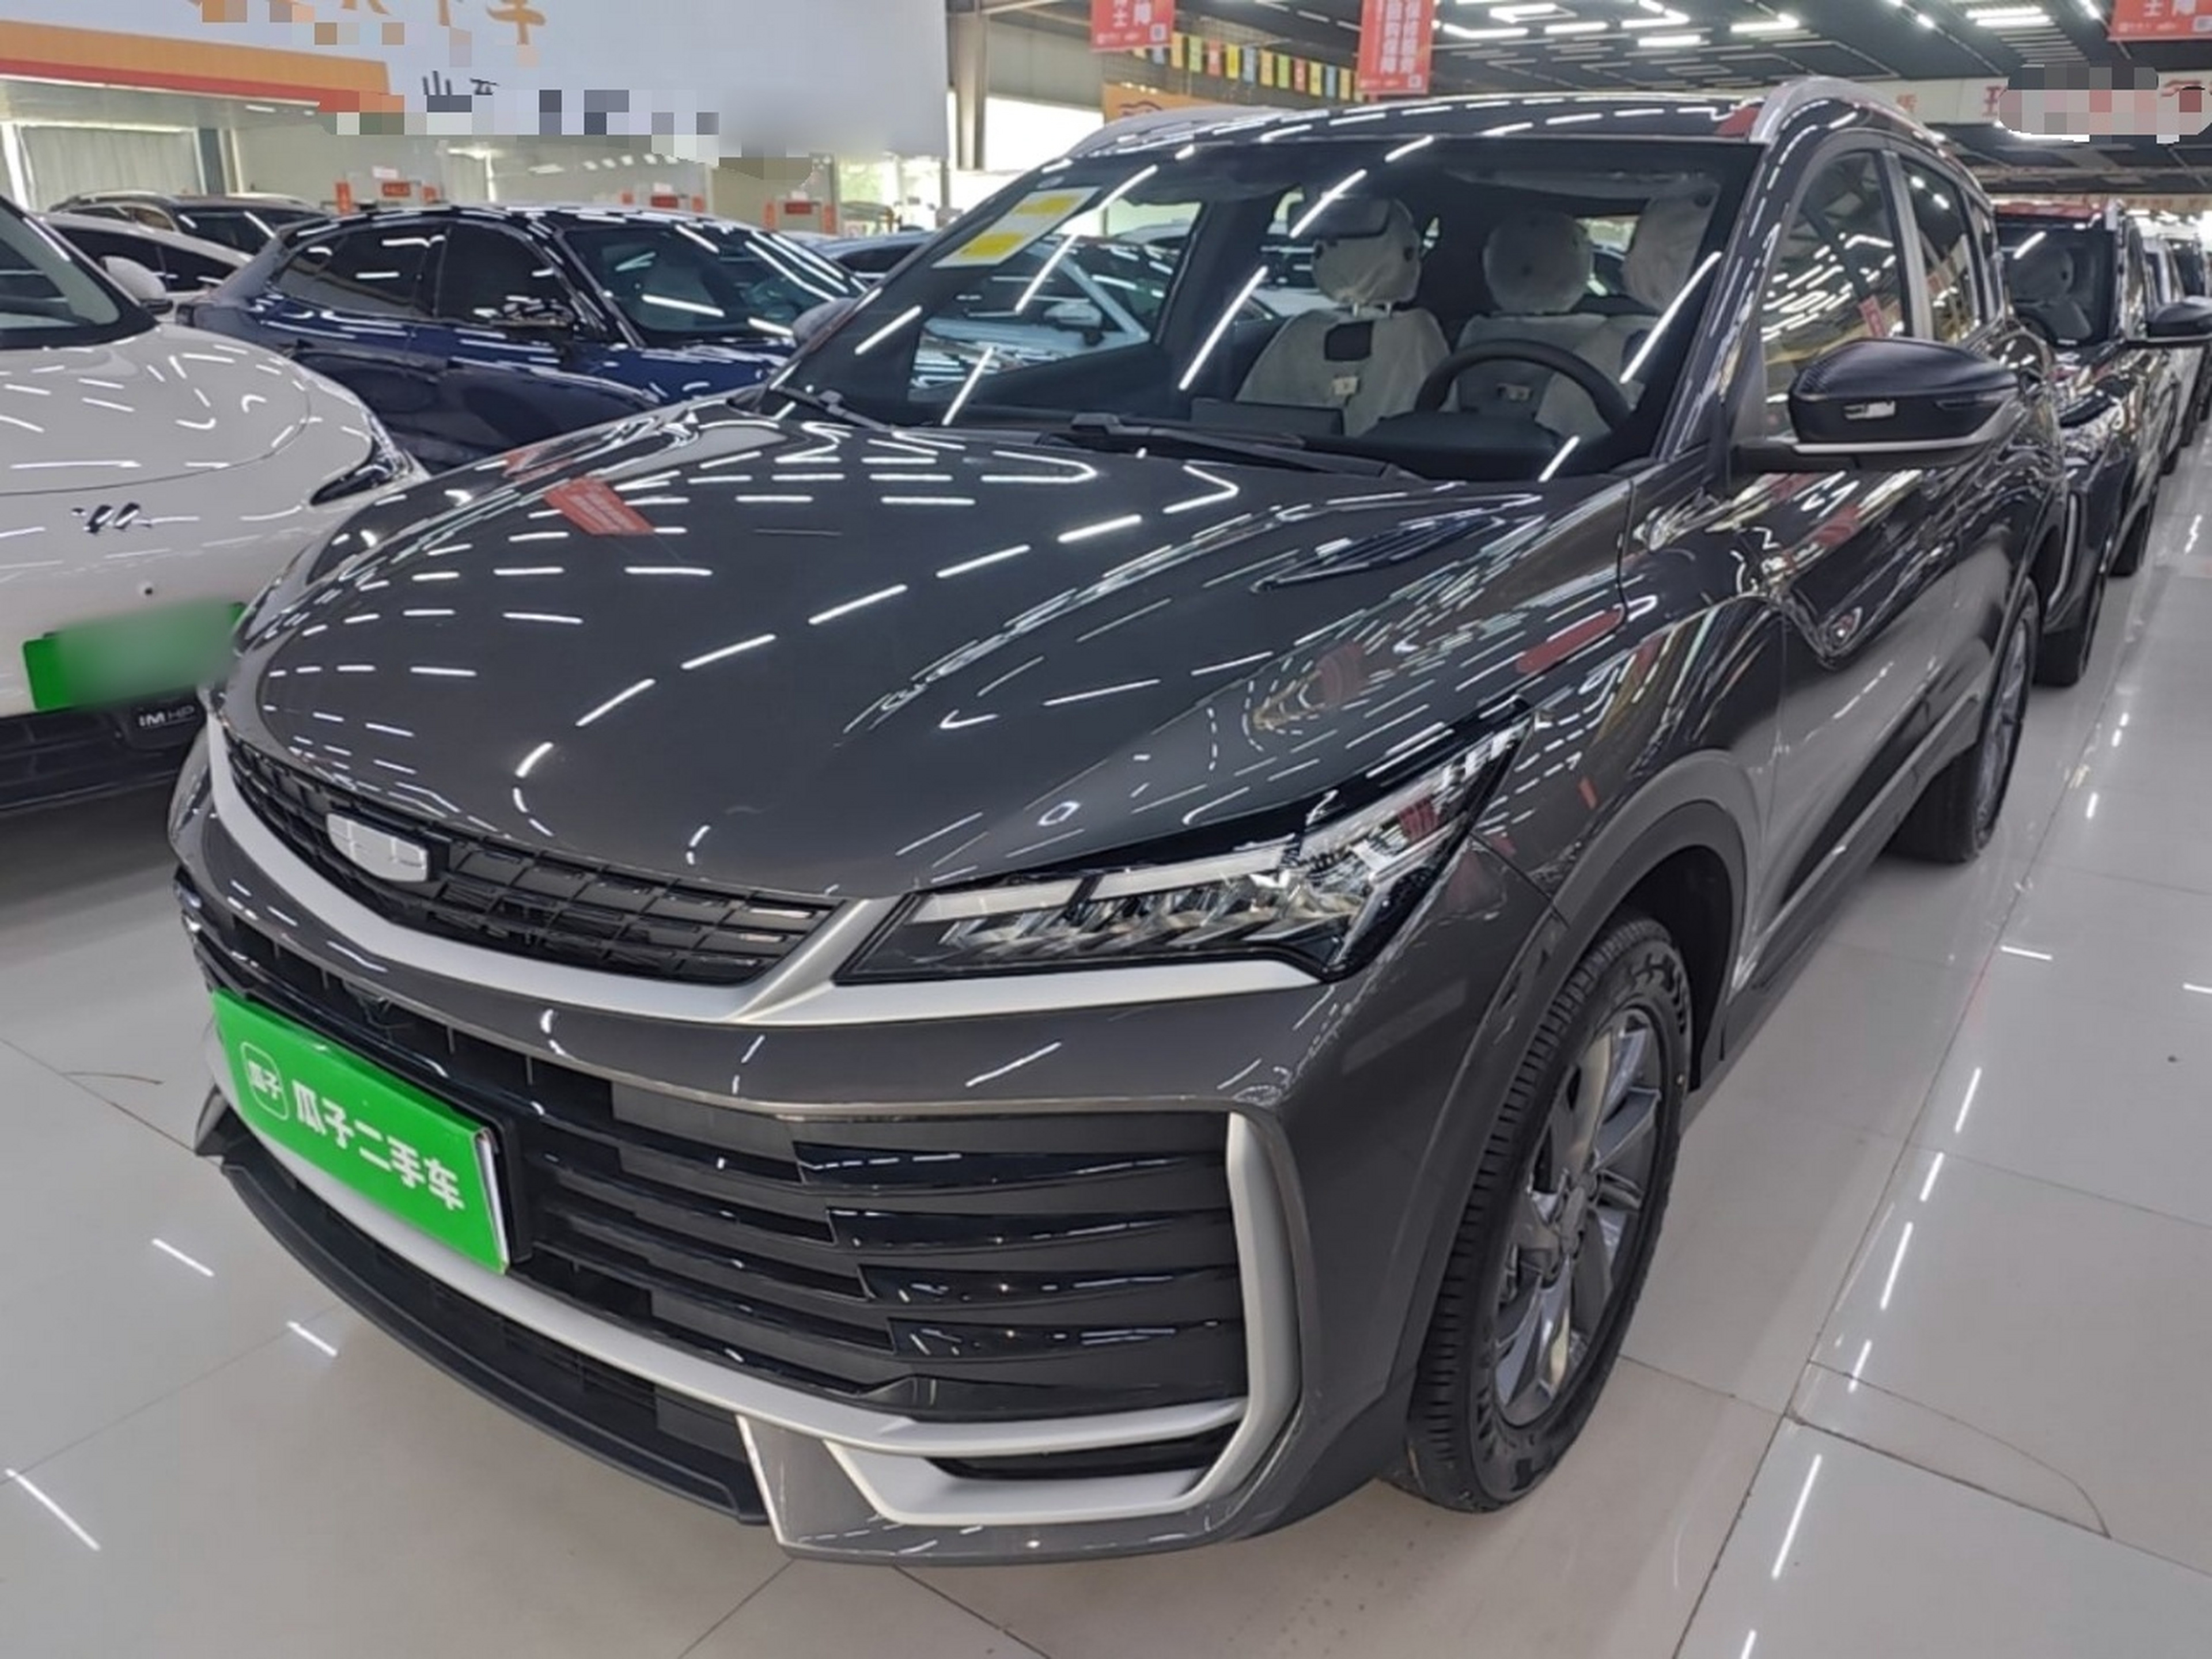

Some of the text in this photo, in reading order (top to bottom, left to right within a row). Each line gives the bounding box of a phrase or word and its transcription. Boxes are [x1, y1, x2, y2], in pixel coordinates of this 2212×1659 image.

[292, 1080, 465, 1211] 瓜子二手车
